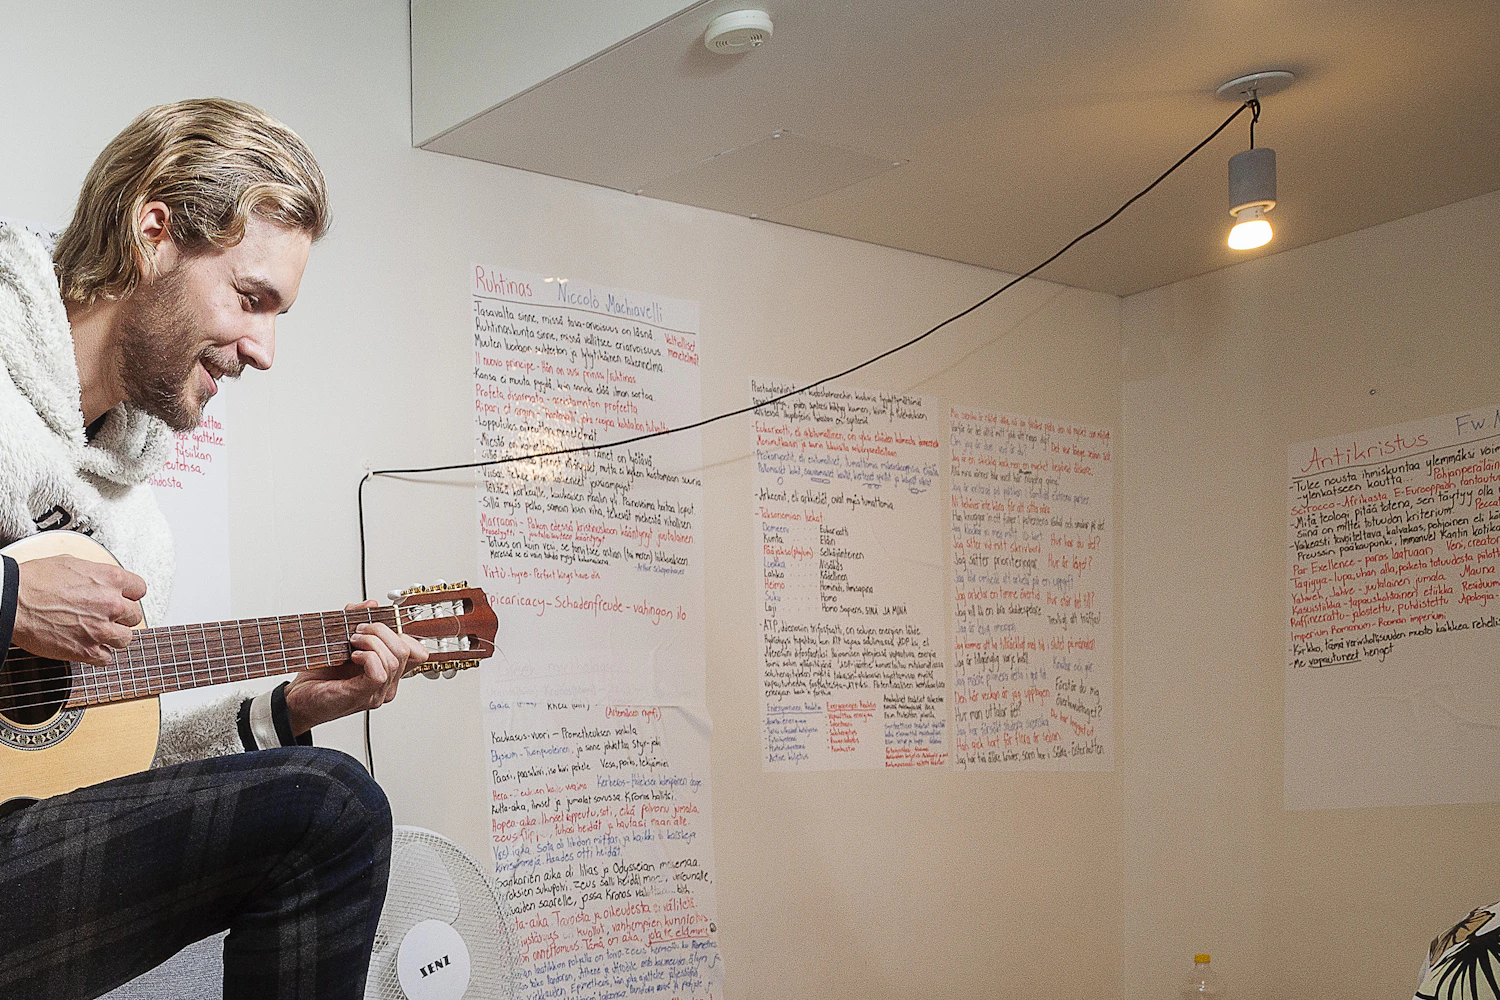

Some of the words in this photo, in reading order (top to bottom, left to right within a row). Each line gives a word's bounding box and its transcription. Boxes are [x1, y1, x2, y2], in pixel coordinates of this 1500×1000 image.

[475, 265, 533, 297] Ruhtinas
[605, 293, 663, 322] Machiavelli
[1301, 433, 1429, 474] Antikristus
[488, 593, 546, 617] picaricacy
[555, 593, 623, 618] Schadenfreude
[633, 599, 674, 626] vahingon
